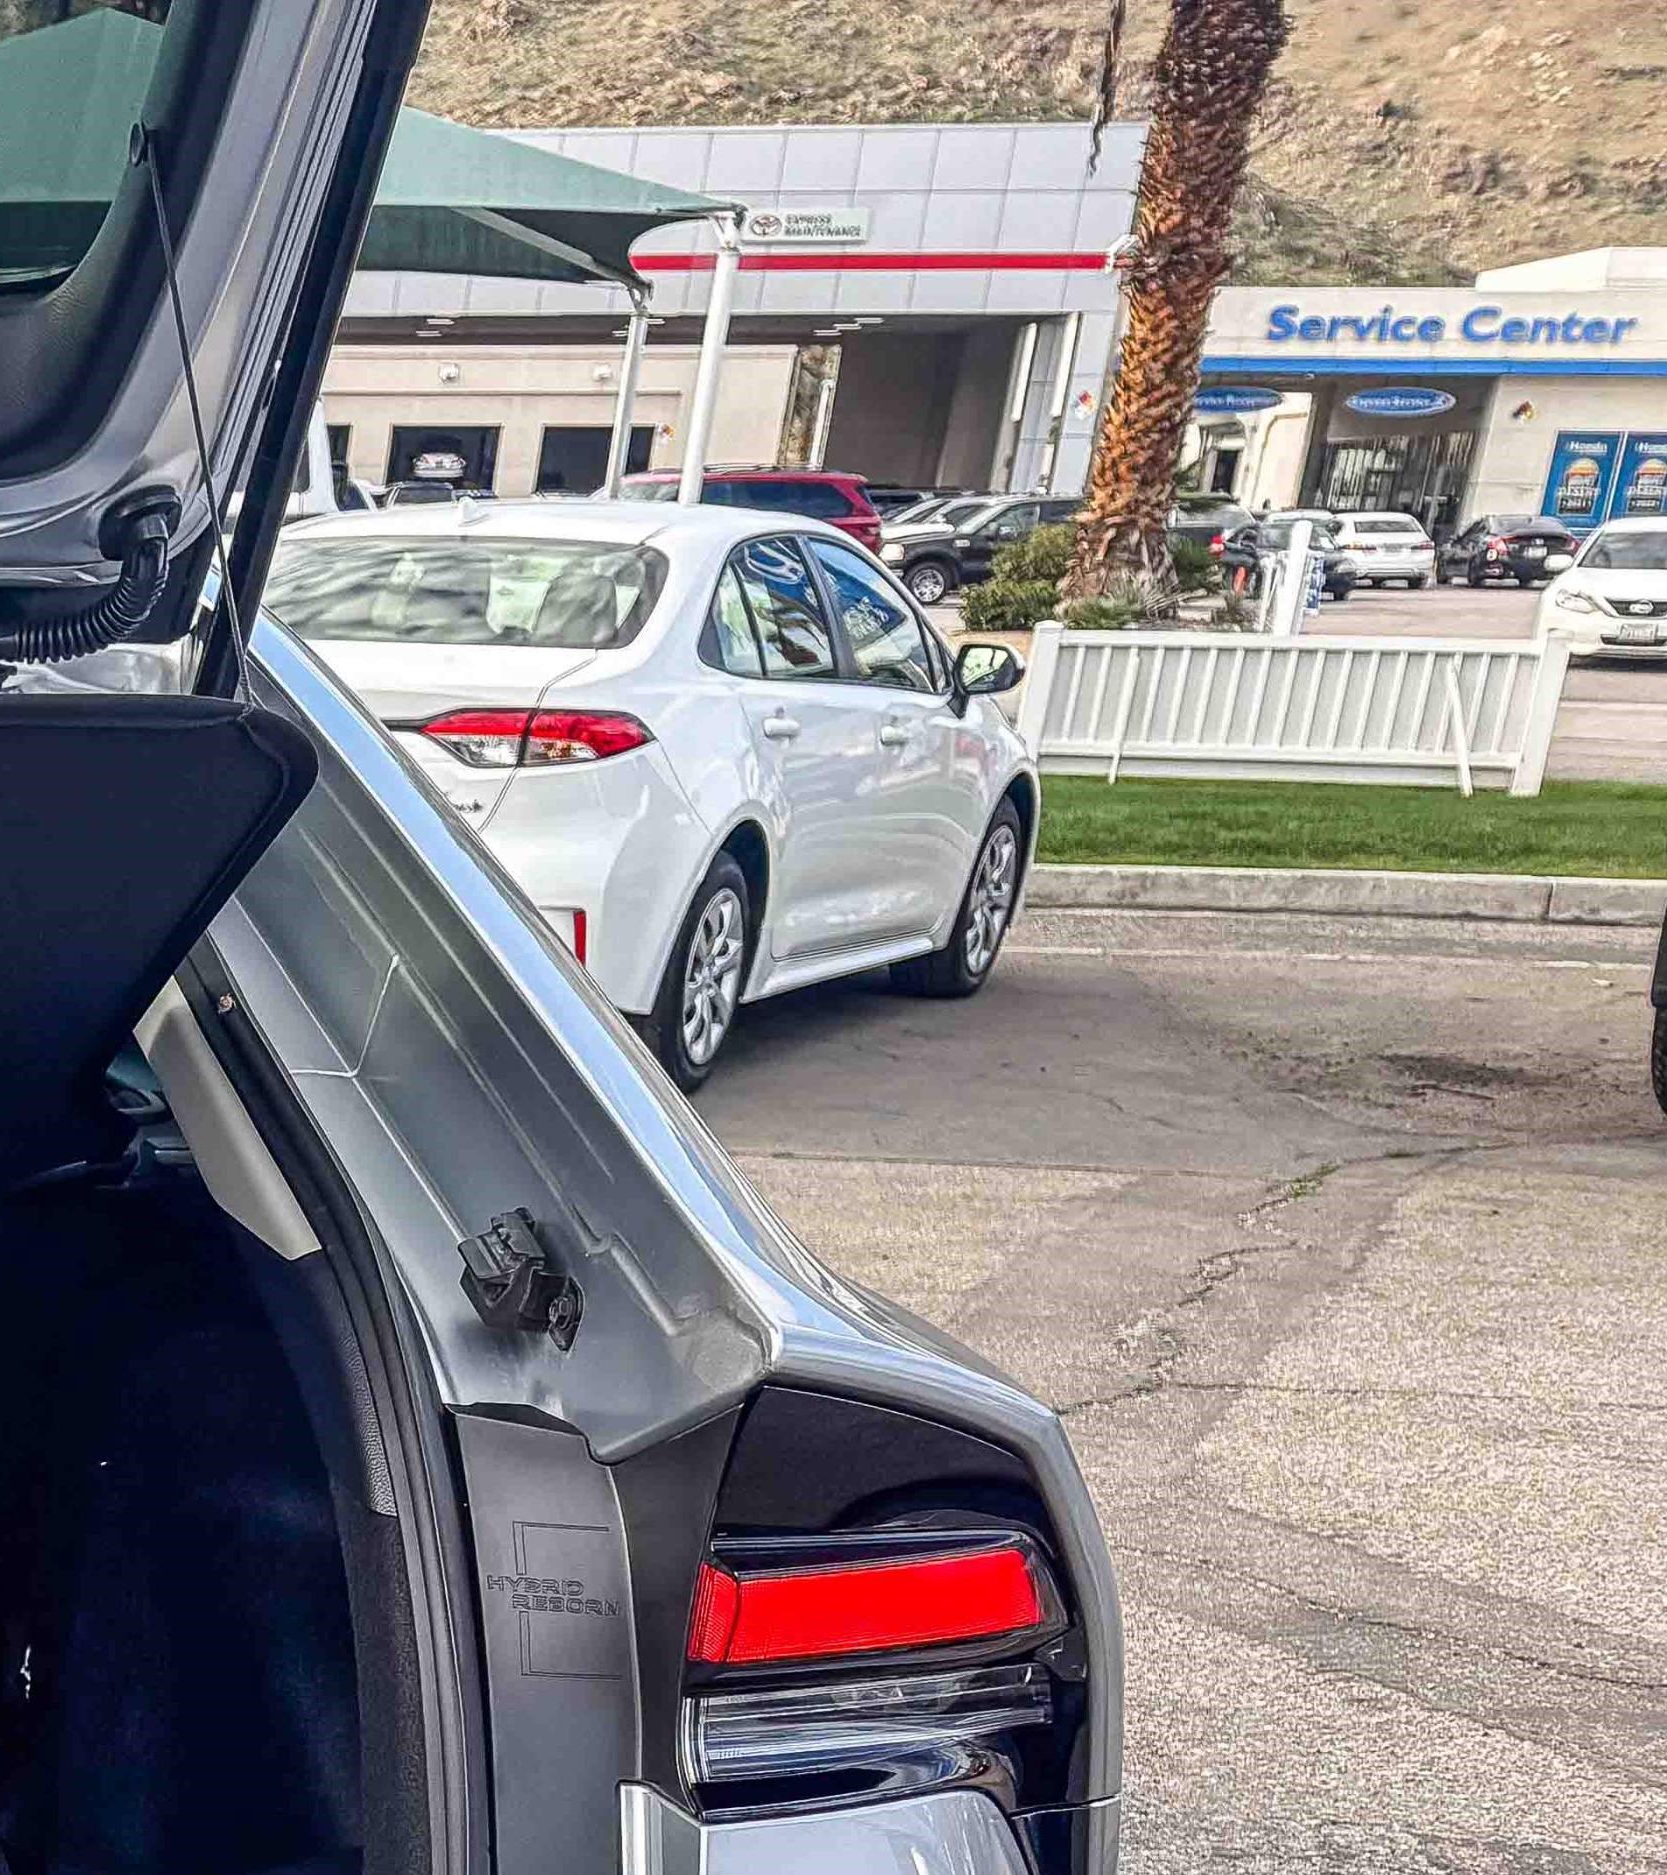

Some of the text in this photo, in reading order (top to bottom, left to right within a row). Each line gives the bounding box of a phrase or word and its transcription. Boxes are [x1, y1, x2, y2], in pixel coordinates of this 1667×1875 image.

[784, 225, 862, 237] MAINTENANCE
[1266, 303, 1639, 342] Service Center
[486, 1574, 585, 1596] HYBRID
[512, 1593, 620, 1616] REBORN
